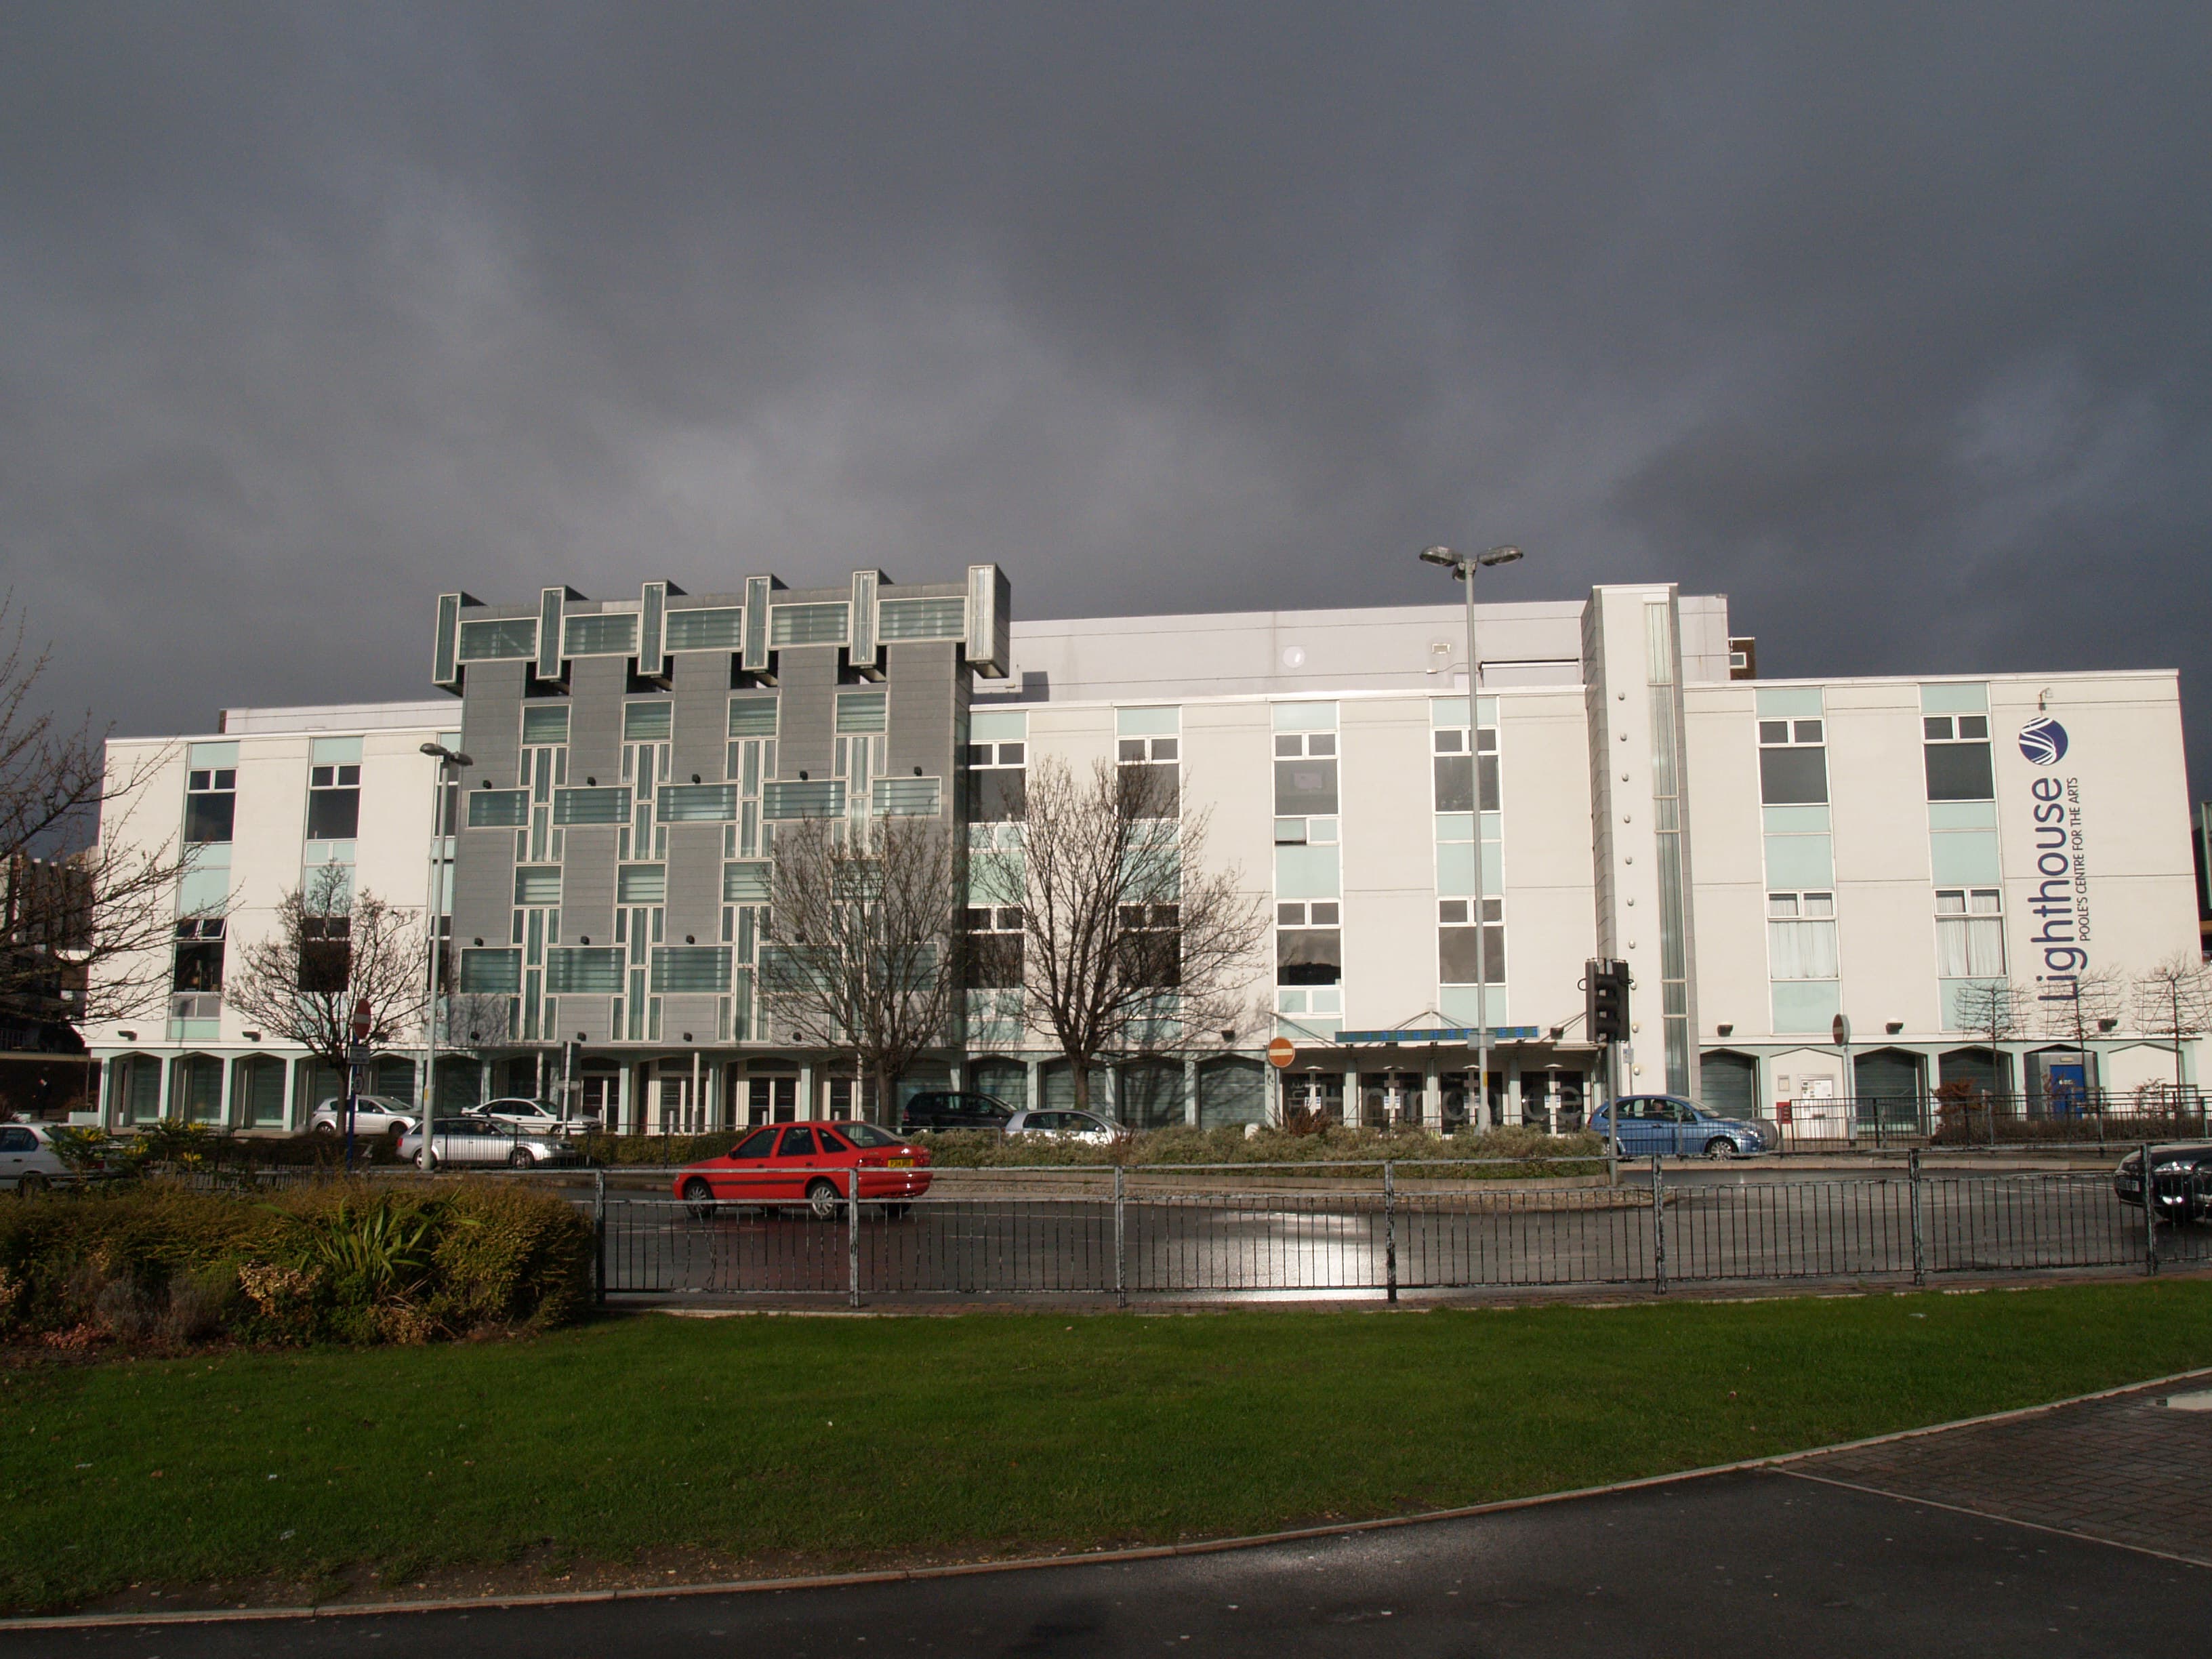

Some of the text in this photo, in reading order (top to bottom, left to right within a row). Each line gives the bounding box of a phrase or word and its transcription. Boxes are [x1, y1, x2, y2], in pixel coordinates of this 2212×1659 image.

[2027, 777, 2088, 1001] Lighthouse
[2067, 777, 2091, 941] POOLE'S CENTRE FOR THE ARTS
